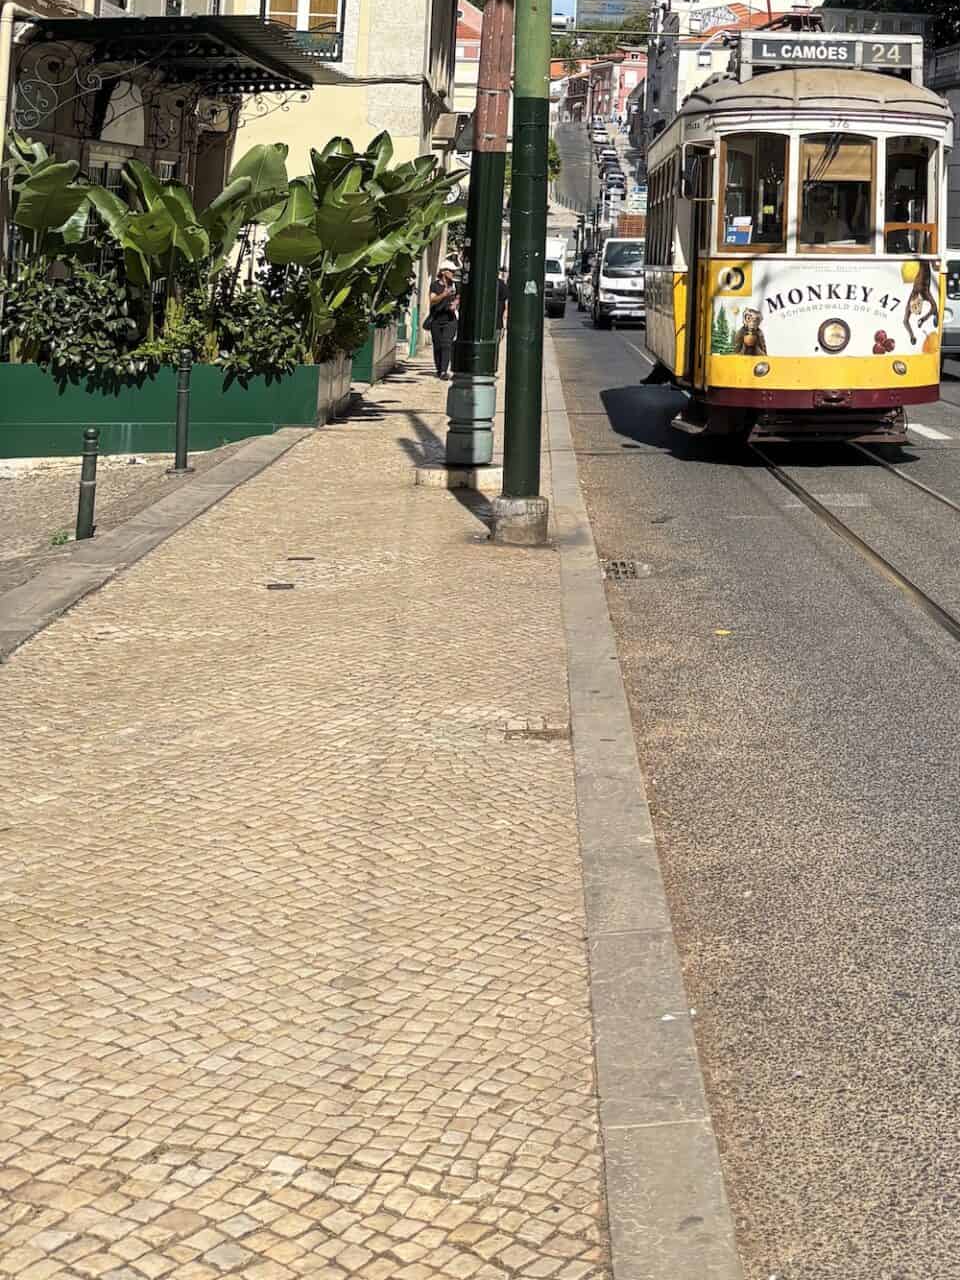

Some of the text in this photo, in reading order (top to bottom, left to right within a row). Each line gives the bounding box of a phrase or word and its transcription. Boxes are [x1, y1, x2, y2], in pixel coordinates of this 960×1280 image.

[762, 44, 776, 57] L.
[871, 44, 901, 63] 24
[765, 283, 902, 314] MONKEY 47
